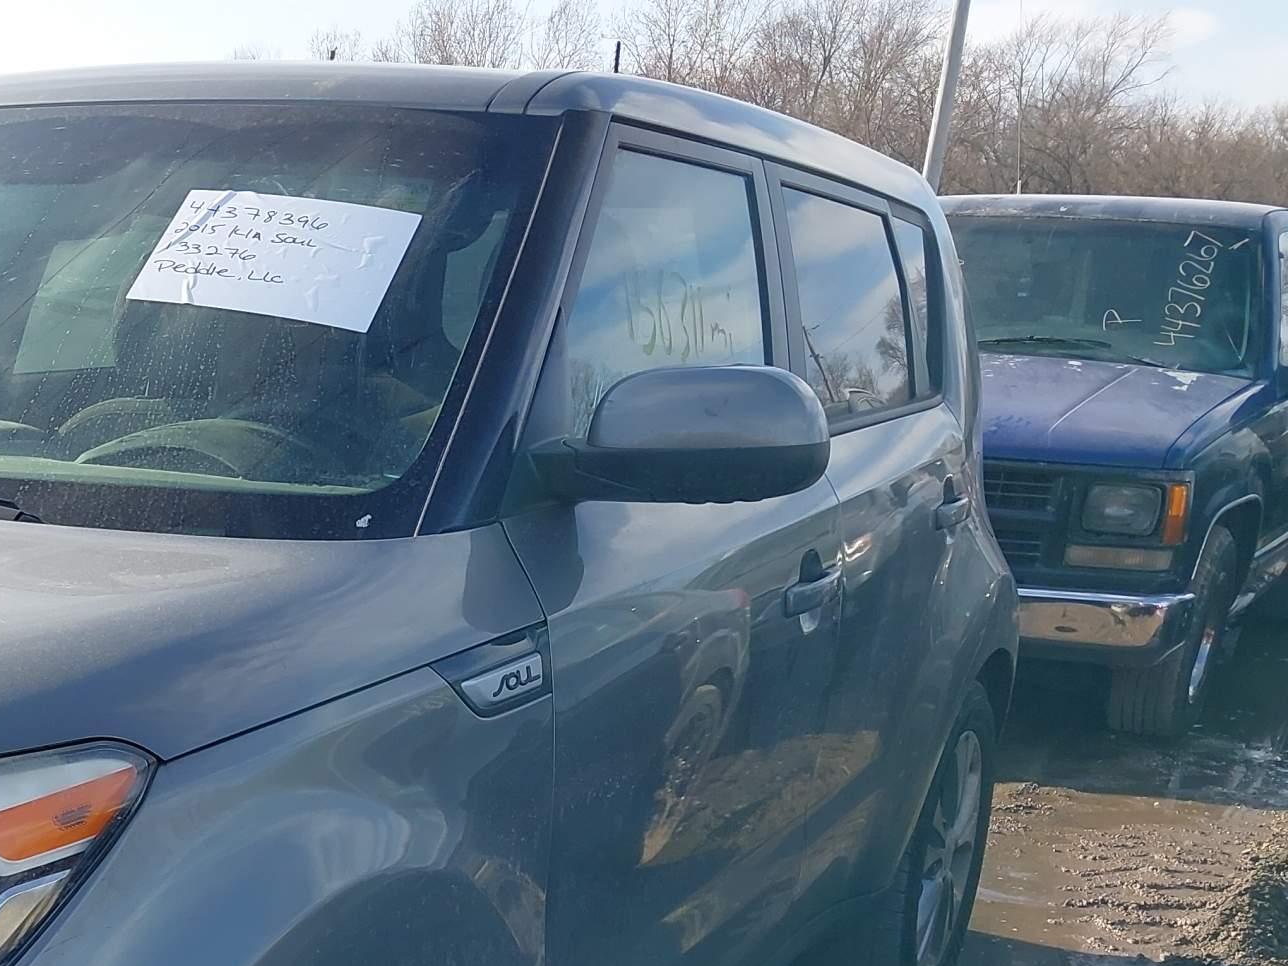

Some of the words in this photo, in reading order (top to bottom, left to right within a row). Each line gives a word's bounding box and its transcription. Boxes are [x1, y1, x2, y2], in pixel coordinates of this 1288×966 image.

[174, 221, 226, 235] 2015
[228, 224, 262, 241] KIA
[190, 200, 329, 231] 44378396
[156, 240, 257, 261] 133276
[1153, 230, 1224, 347] 44376267
[492, 664, 541, 698] SOUL
